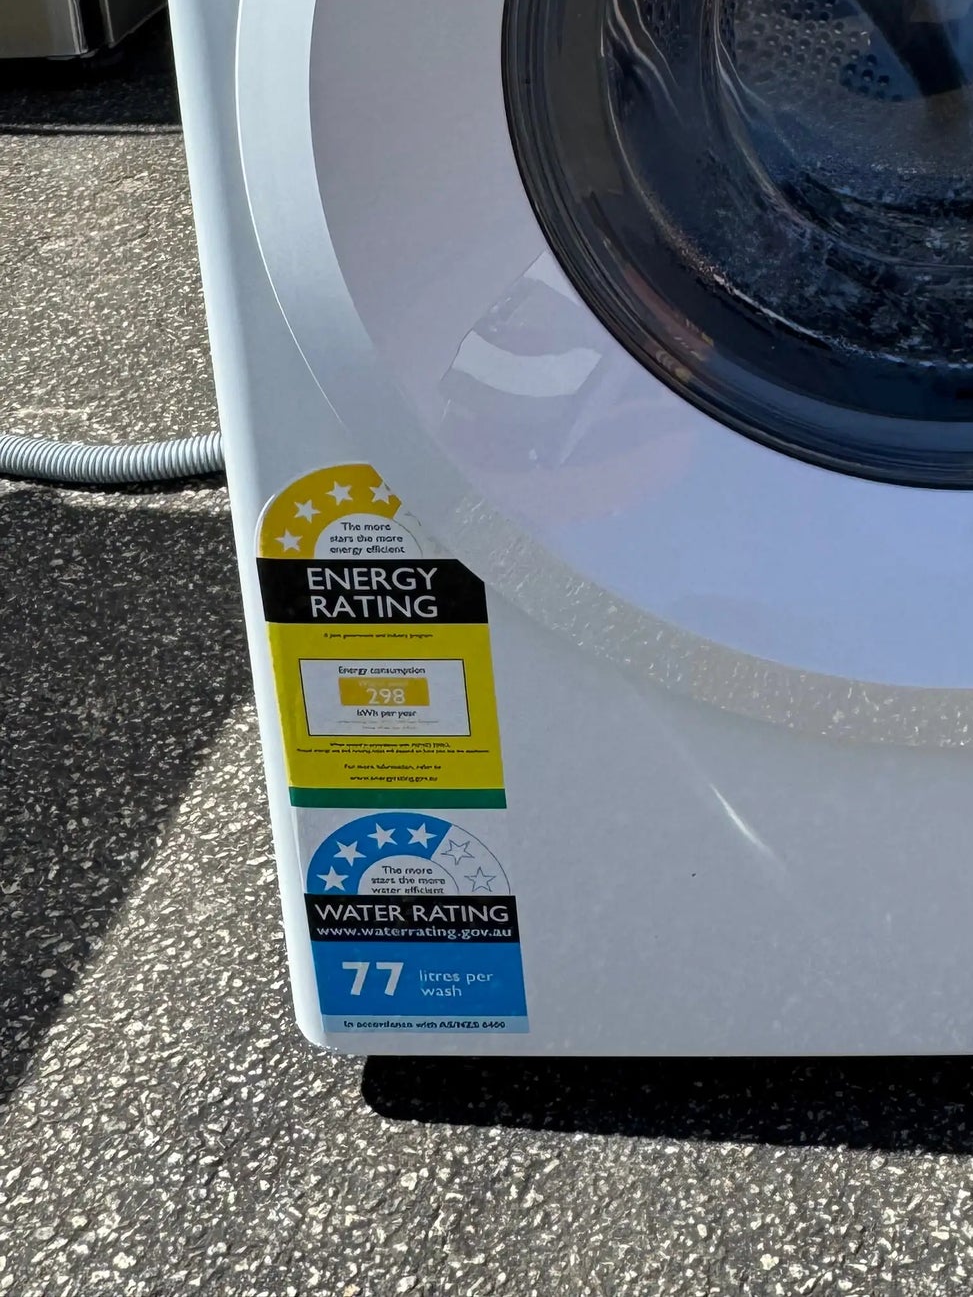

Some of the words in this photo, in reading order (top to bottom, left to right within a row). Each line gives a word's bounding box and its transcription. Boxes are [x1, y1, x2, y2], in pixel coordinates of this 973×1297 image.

[341, 522, 361, 531] The
[330, 535, 353, 543] stars
[357, 534, 373, 543] the
[376, 535, 403, 543] more
[330, 546, 362, 556] energy
[366, 544, 405, 553] efficient
[306, 567, 438, 591] ENERGY
[310, 595, 438, 618] RATING
[338, 665, 367, 675] Energy
[370, 666, 426, 675] consumption
[366, 688, 406, 704] 298
[381, 710, 396, 718] per
[398, 710, 416, 718] year
[382, 866, 402, 875] The
[404, 867, 432, 875] more
[399, 876, 415, 885] the
[404, 886, 444, 894] efficient
[315, 904, 404, 922] WATER
[413, 905, 509, 923] RATING
[317, 925, 512, 940] www.waterrating.gov.au
[342, 961, 404, 996] 77
[419, 969, 460, 982] litres
[466, 972, 493, 985] per
[420, 985, 462, 997] wash
